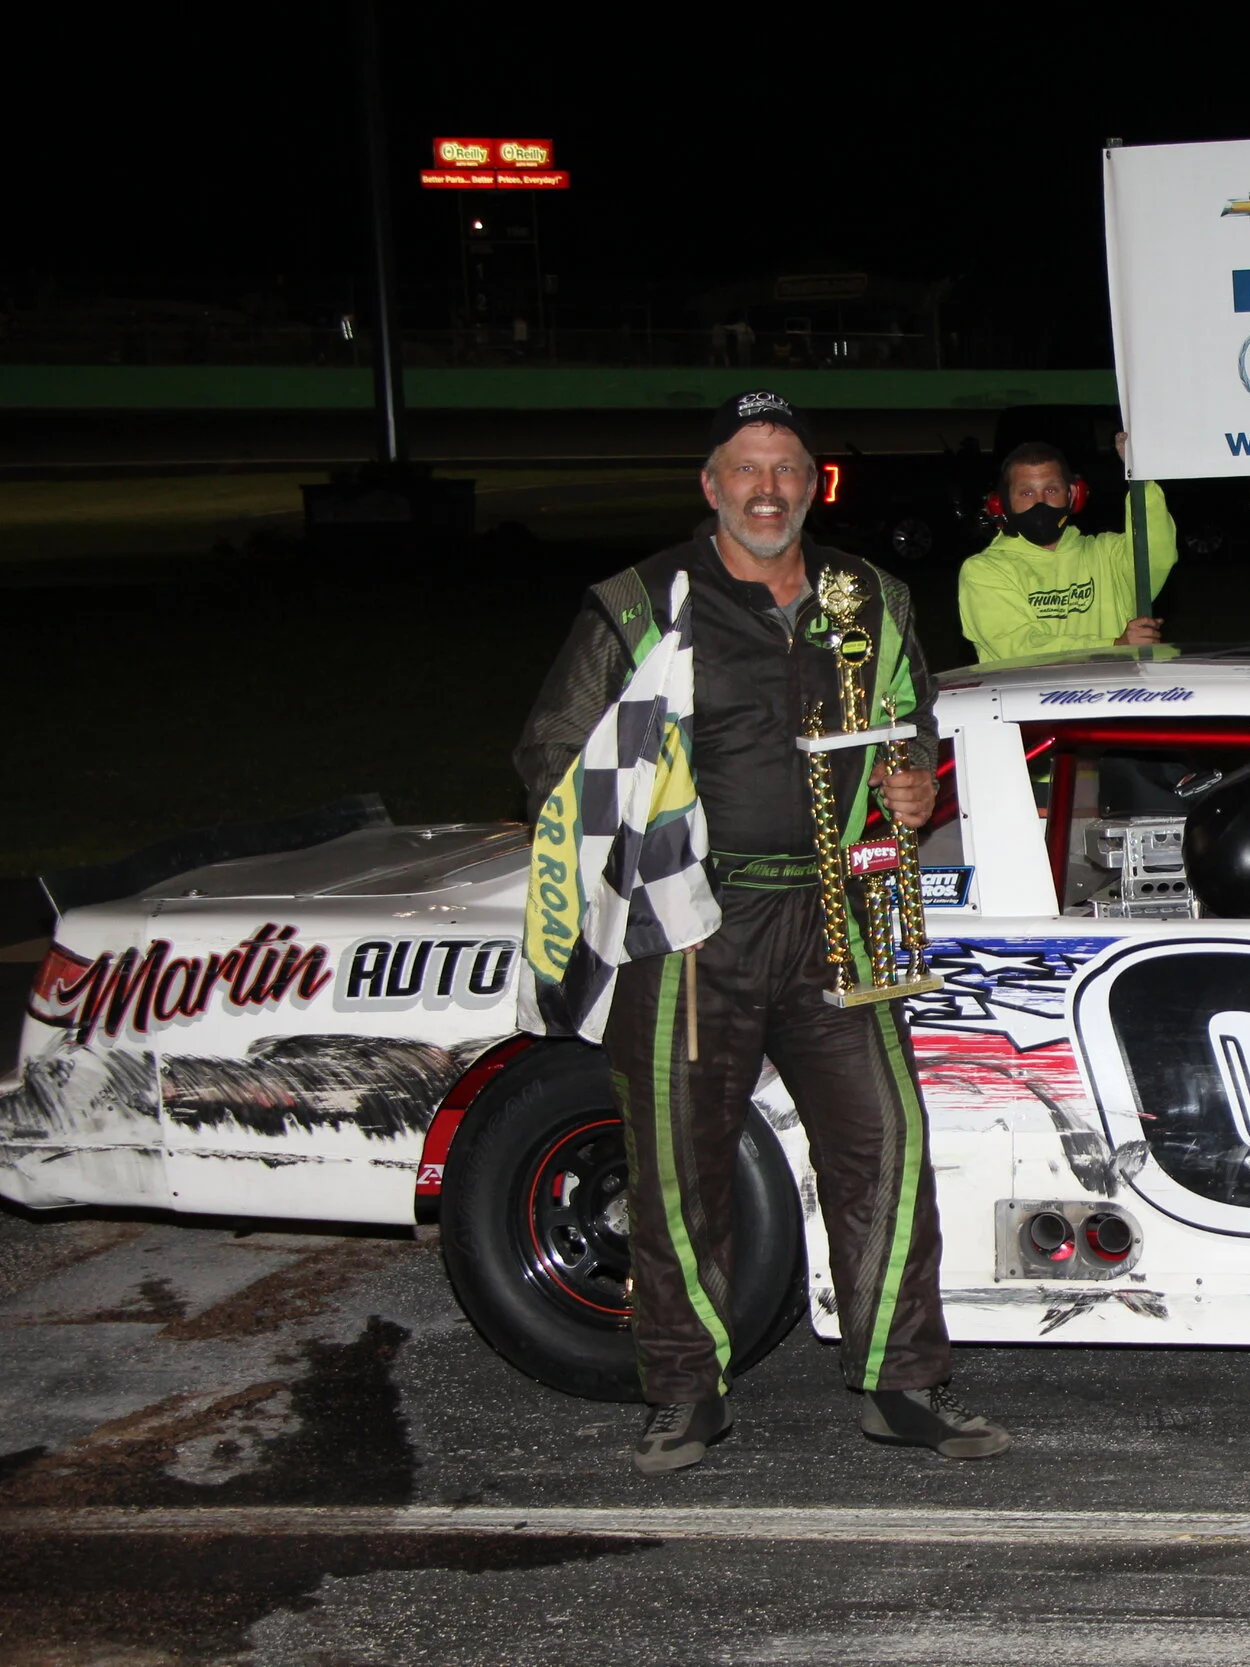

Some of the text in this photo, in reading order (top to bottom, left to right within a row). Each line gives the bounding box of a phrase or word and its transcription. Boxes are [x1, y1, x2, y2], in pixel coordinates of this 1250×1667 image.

[442, 143, 488, 162] O'Reilly
[502, 143, 548, 163] O'Reilly
[1039, 687, 1194, 705] Mike Martin
[853, 847, 897, 870] Myers
[783, 862, 818, 876] Marti
[921, 885, 958, 897] ROS.
[56, 923, 517, 1046] Martin AUTO
